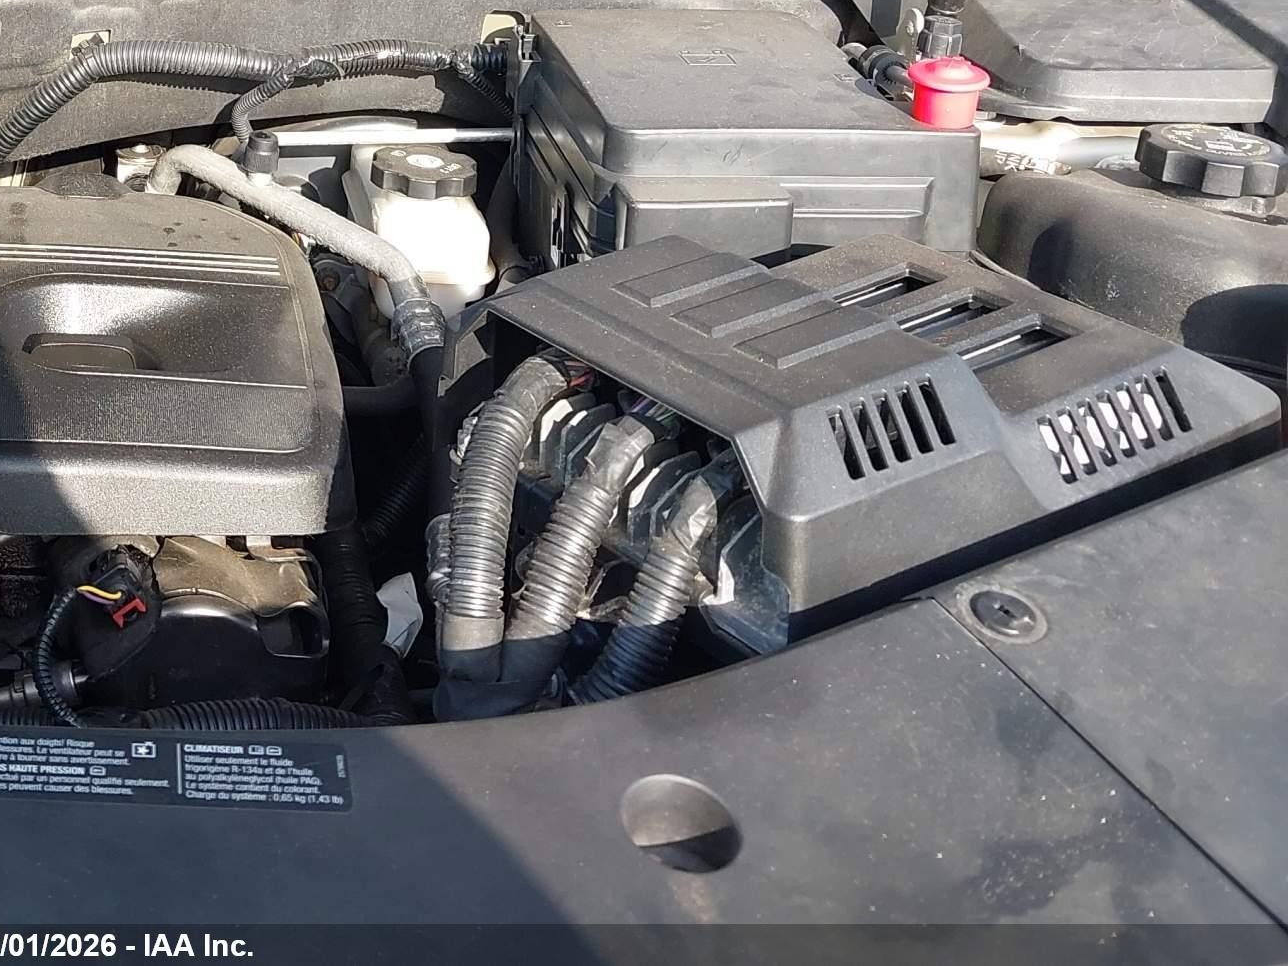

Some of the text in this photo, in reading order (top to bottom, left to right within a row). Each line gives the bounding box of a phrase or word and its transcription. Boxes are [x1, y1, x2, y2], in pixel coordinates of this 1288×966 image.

[66, 739, 94, 748] Risque
[184, 744, 244, 754] CLIMATISEUR
[70, 757, 130, 765] avertissement.
[184, 755, 294, 766] Utiliser seulement le fluide
[8, 764, 38, 772] HAUTE
[40, 765, 85, 774] PRESSION
[232, 765, 263, 774] R-134a
[275, 766, 286, 774] de
[49, 776, 90, 784] personnel
[124, 779, 170, 788] seulement.
[8, 783, 42, 791] peuvent
[74, 785, 90, 793] des
[91, 786, 134, 794] blessures.
[186, 790, 216, 800] Charge
[273, 794, 293, 802] 0,65
[294, 795, 306, 804] kg
